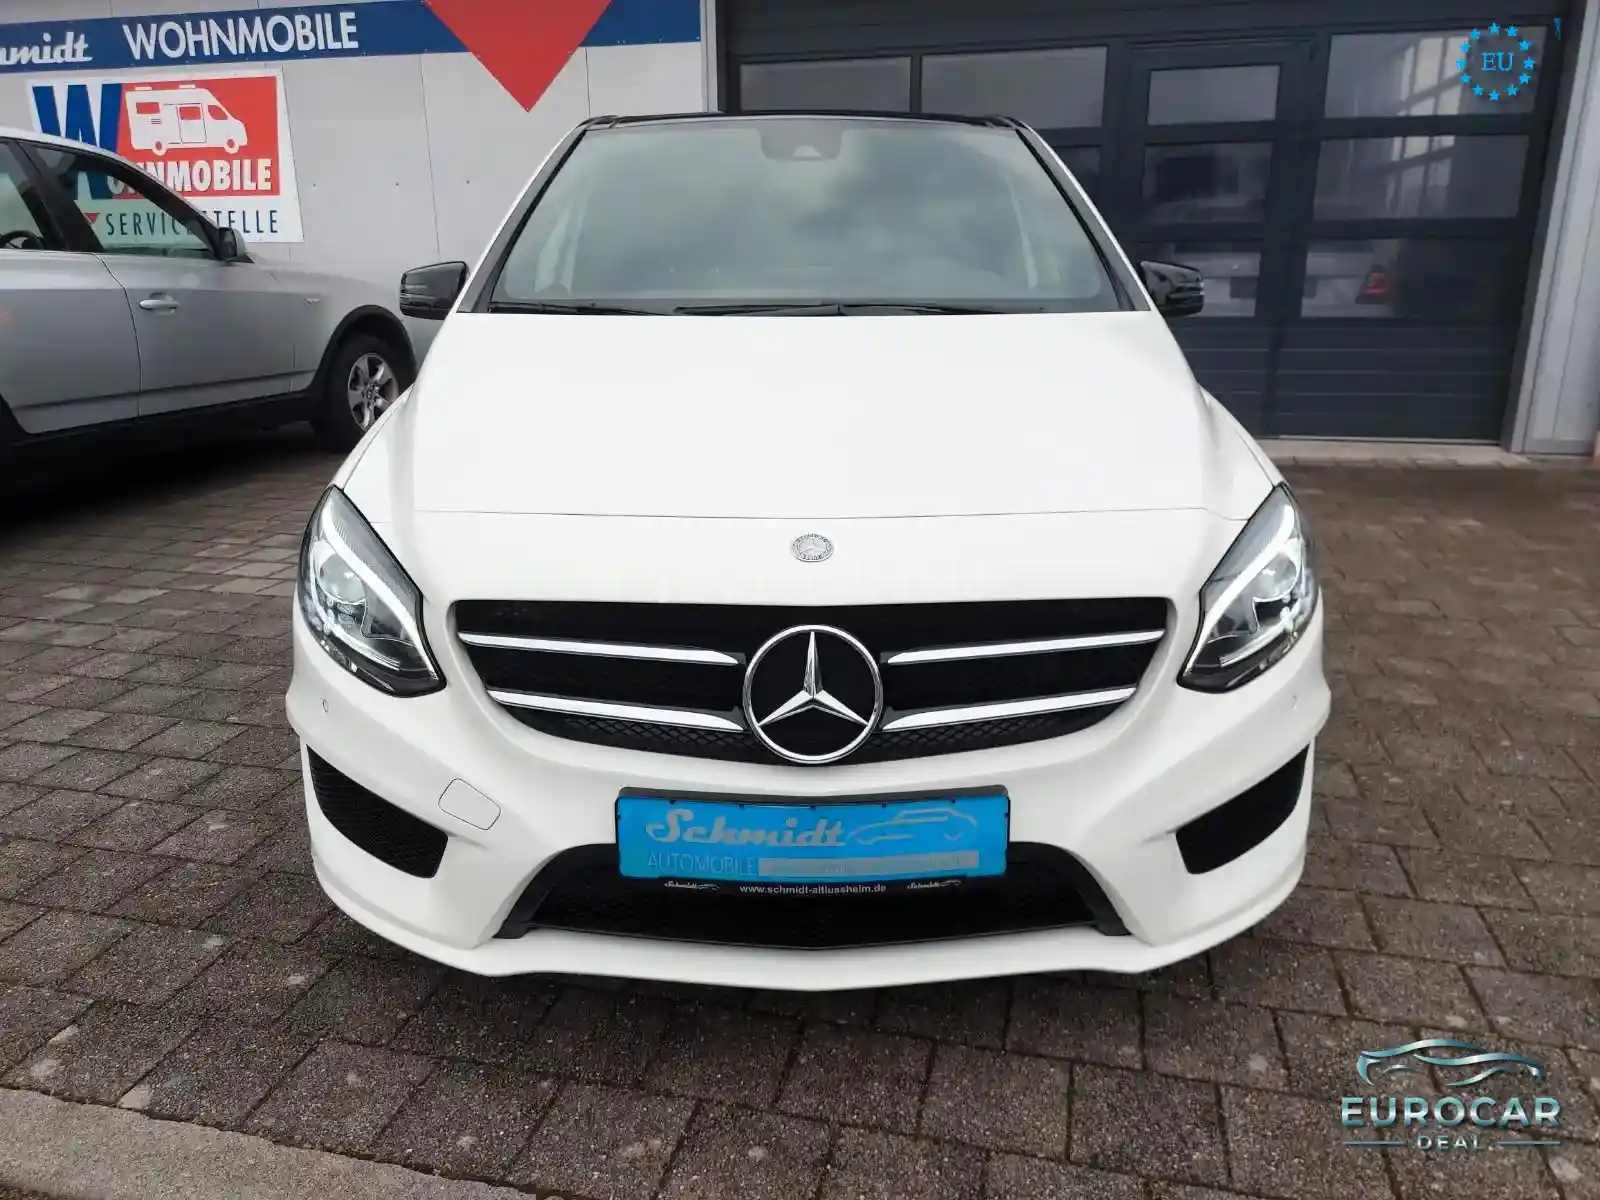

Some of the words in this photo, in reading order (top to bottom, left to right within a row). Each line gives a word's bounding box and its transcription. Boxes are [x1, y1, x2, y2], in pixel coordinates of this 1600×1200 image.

[122, 12, 359, 60] WOHNMOBILE
[105, 210, 279, 236] SERVICTELLE
[646, 808, 849, 848] Schmidt
[647, 850, 757, 877] AUTOMOBILE
